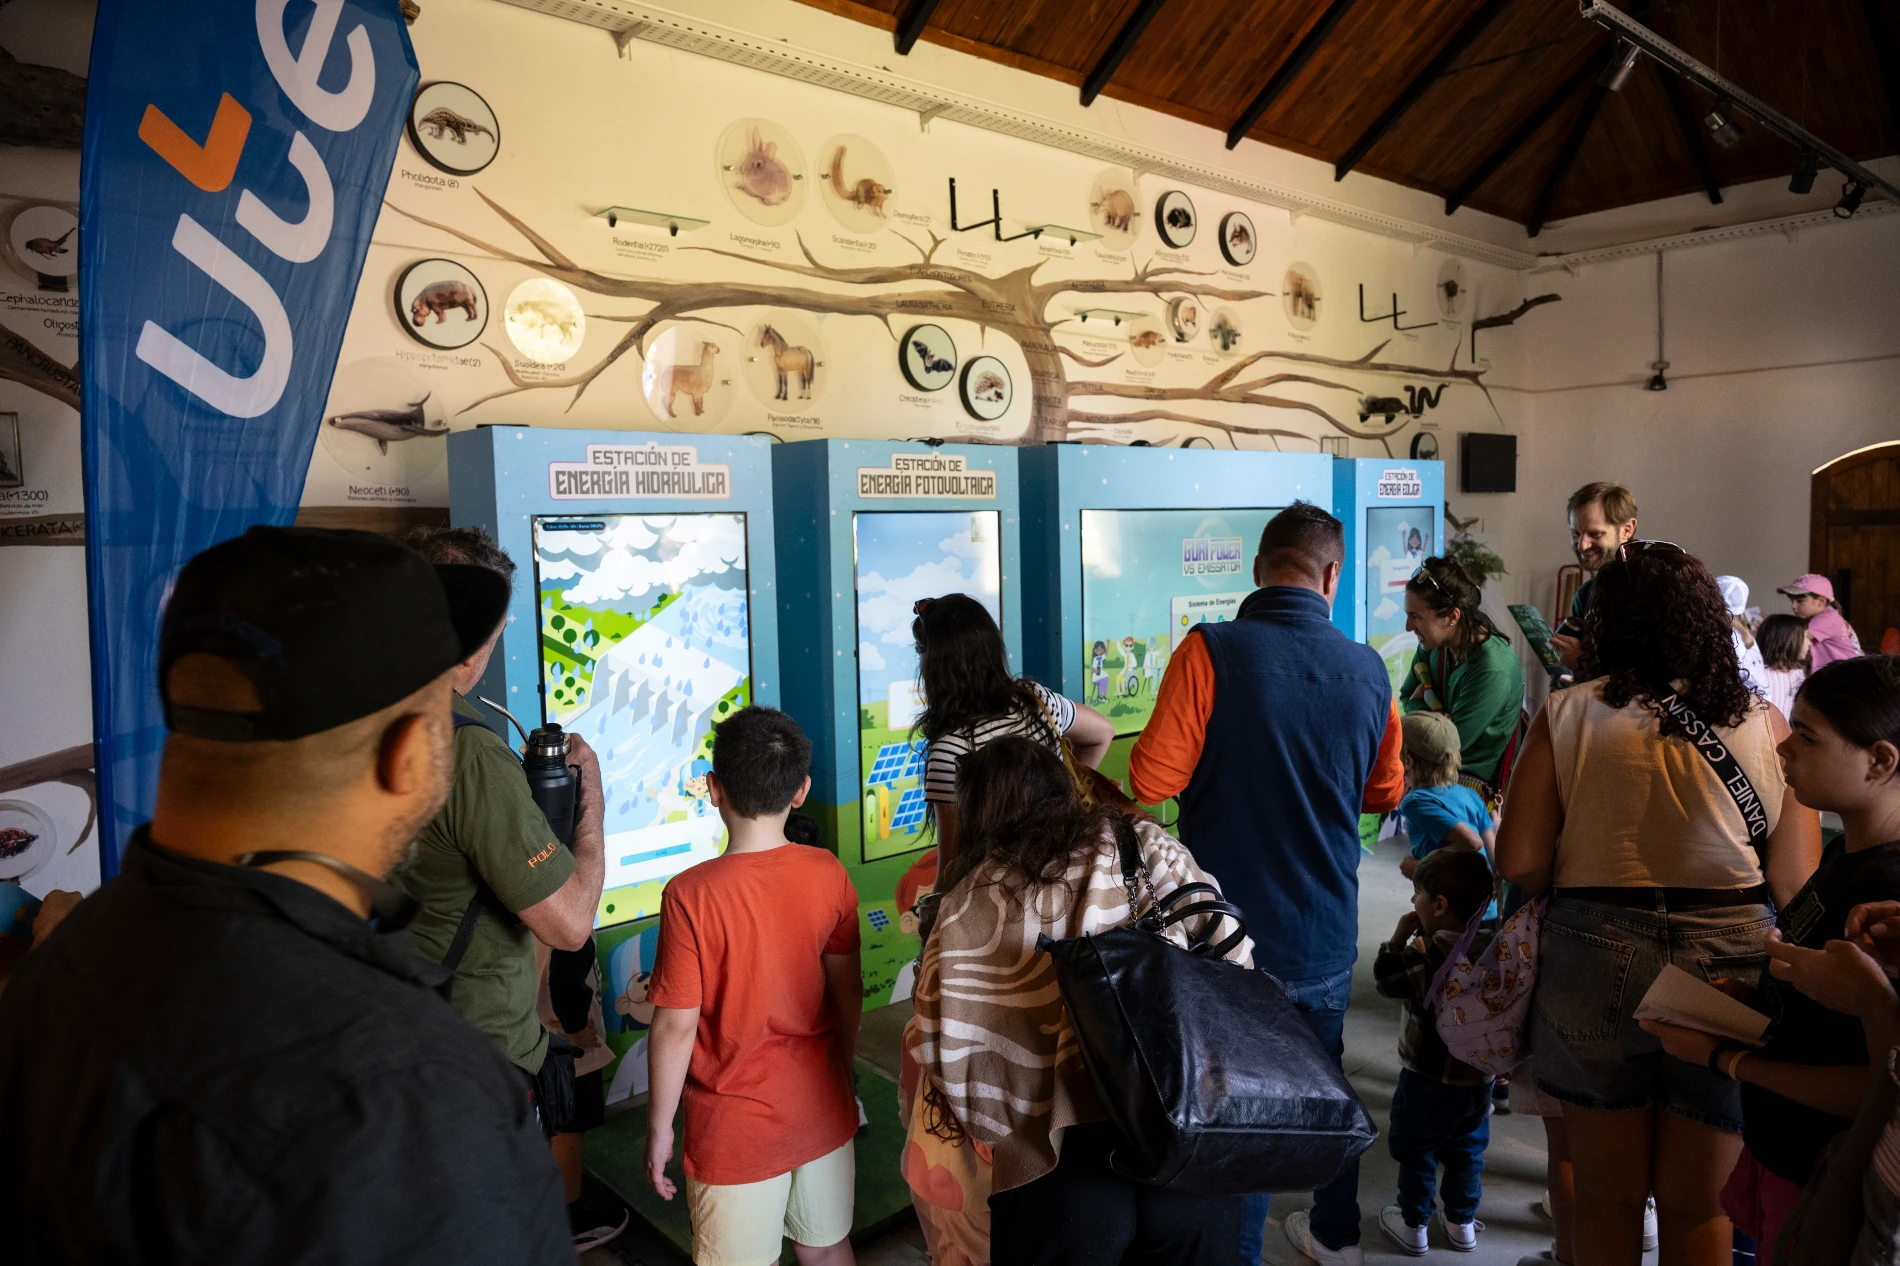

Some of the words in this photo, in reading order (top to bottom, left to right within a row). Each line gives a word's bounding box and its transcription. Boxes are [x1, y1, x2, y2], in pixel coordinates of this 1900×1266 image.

[592, 446, 668, 466] ESTACIÓN
[672, 452, 691, 466] DE
[895, 455, 946, 471] ESTACIÓN
[949, 460, 962, 472] DE
[555, 466, 630, 495] ENERGÍA
[635, 466, 726, 495] HIDRÁULICA
[860, 471, 912, 494] ENERGÍA
[915, 475, 994, 495] FOTOVOLTAICA
[1408, 472, 1415, 481] DE
[348, 485, 387, 495] Neoceti
[1210, 543, 1241, 561] POWER
[1183, 563, 1195, 575] VS
[1188, 600, 1208, 608] Sistema
[1661, 694, 1727, 762] CASSIN
[1727, 766, 1767, 837] DANIEL
[527, 842, 556, 868] POLO
